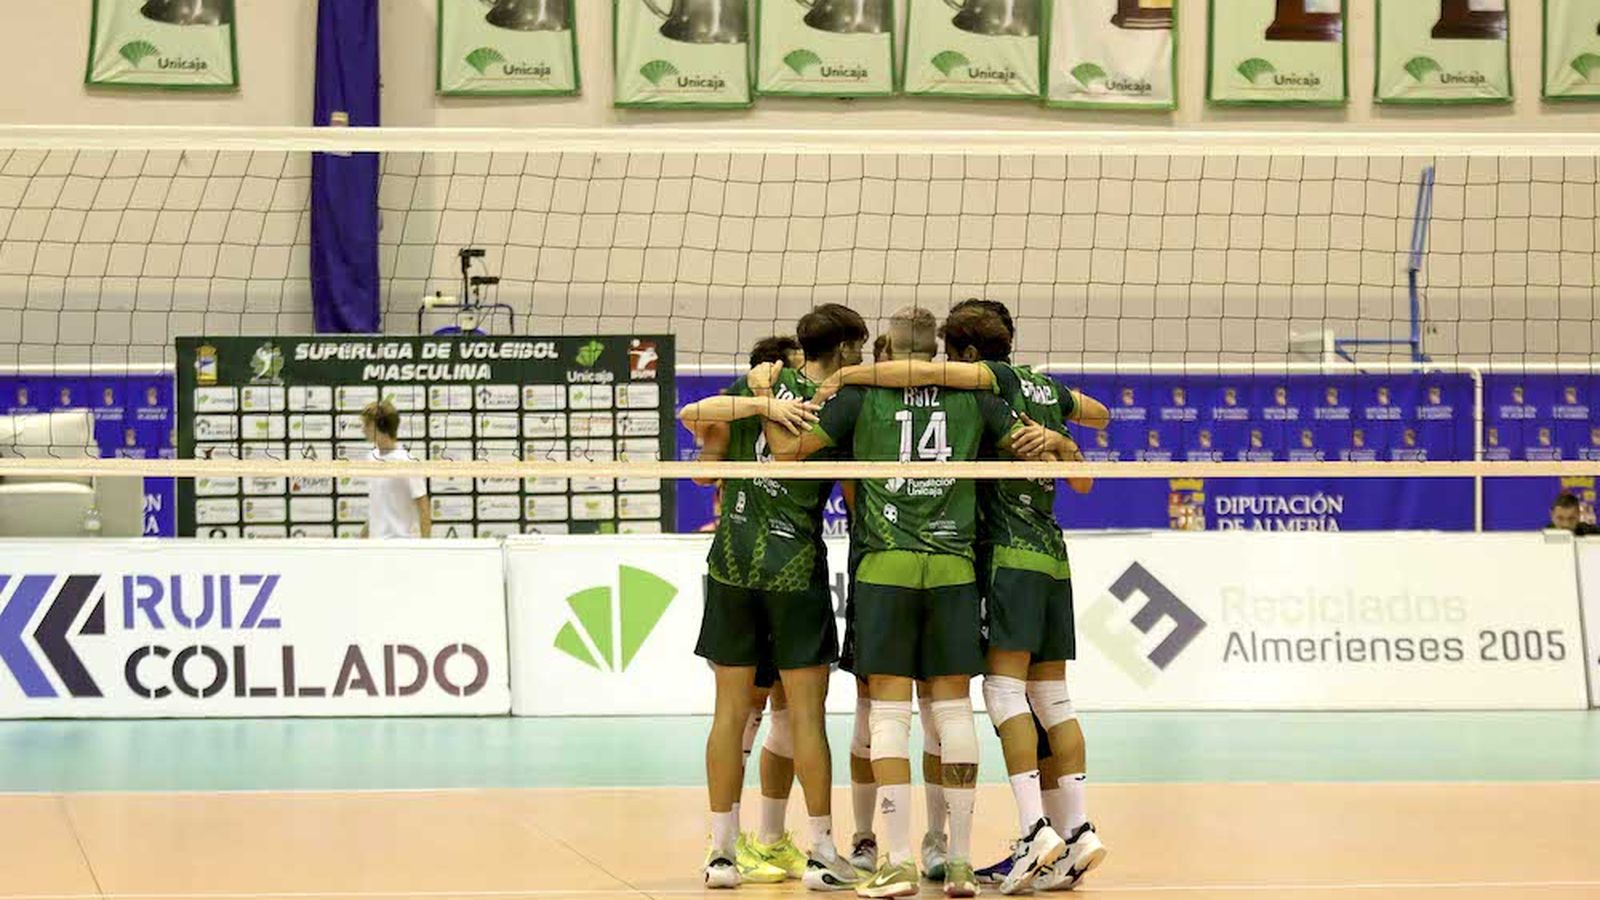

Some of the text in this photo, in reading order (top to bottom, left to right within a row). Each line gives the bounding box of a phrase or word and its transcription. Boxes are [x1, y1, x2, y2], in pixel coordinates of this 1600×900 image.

[157, 57, 208, 72] Unicaja
[502, 63, 551, 78] Unicaja
[820, 65, 868, 79] Unicaja
[968, 67, 1016, 81] Unicaja
[1273, 73, 1321, 87] Unicaja
[1439, 70, 1486, 85] Unicaja
[676, 75, 726, 90] Unicaja
[1104, 78, 1152, 93] Unicaja
[294, 342, 560, 360] SUPERLIGA DE VOLEIBOL
[363, 363, 492, 381] MASCULINA
[566, 370, 614, 384] Unicaja
[895, 410, 953, 463] 14
[907, 486, 943, 497] Unicaja
[1215, 492, 1344, 515] DIPUTACIÓN
[122, 574, 282, 630] RUIZ
[1221, 586, 1468, 624] Reciclados
[1222, 629, 1567, 663] Almerienses 2005
[124, 643, 489, 699] COLLADO
